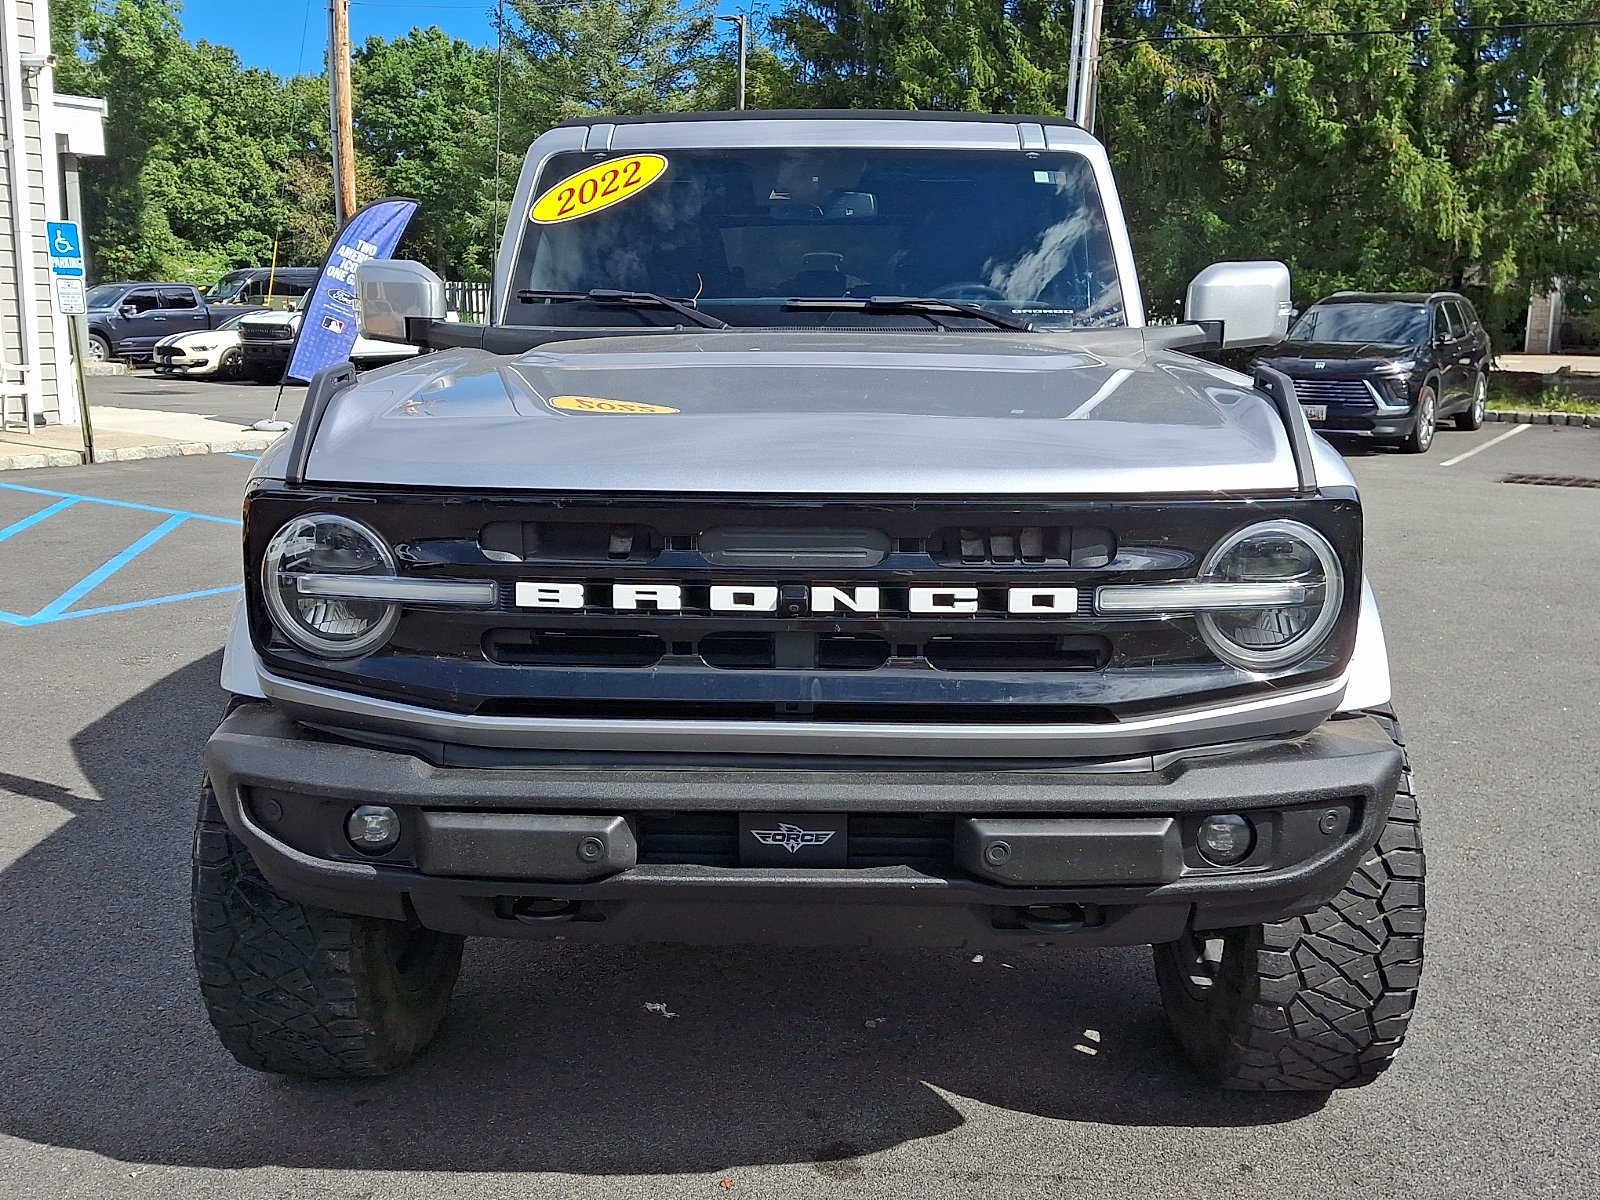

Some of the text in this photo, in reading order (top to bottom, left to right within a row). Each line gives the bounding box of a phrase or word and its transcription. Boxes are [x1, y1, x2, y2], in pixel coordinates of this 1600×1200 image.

[557, 161, 641, 216] 2022
[356, 240, 377, 256] TWO
[51, 256, 82, 269] PARKING
[327, 266, 348, 282] ONE
[515, 581, 1078, 615] BRONCO
[752, 829, 834, 844] FORCE
